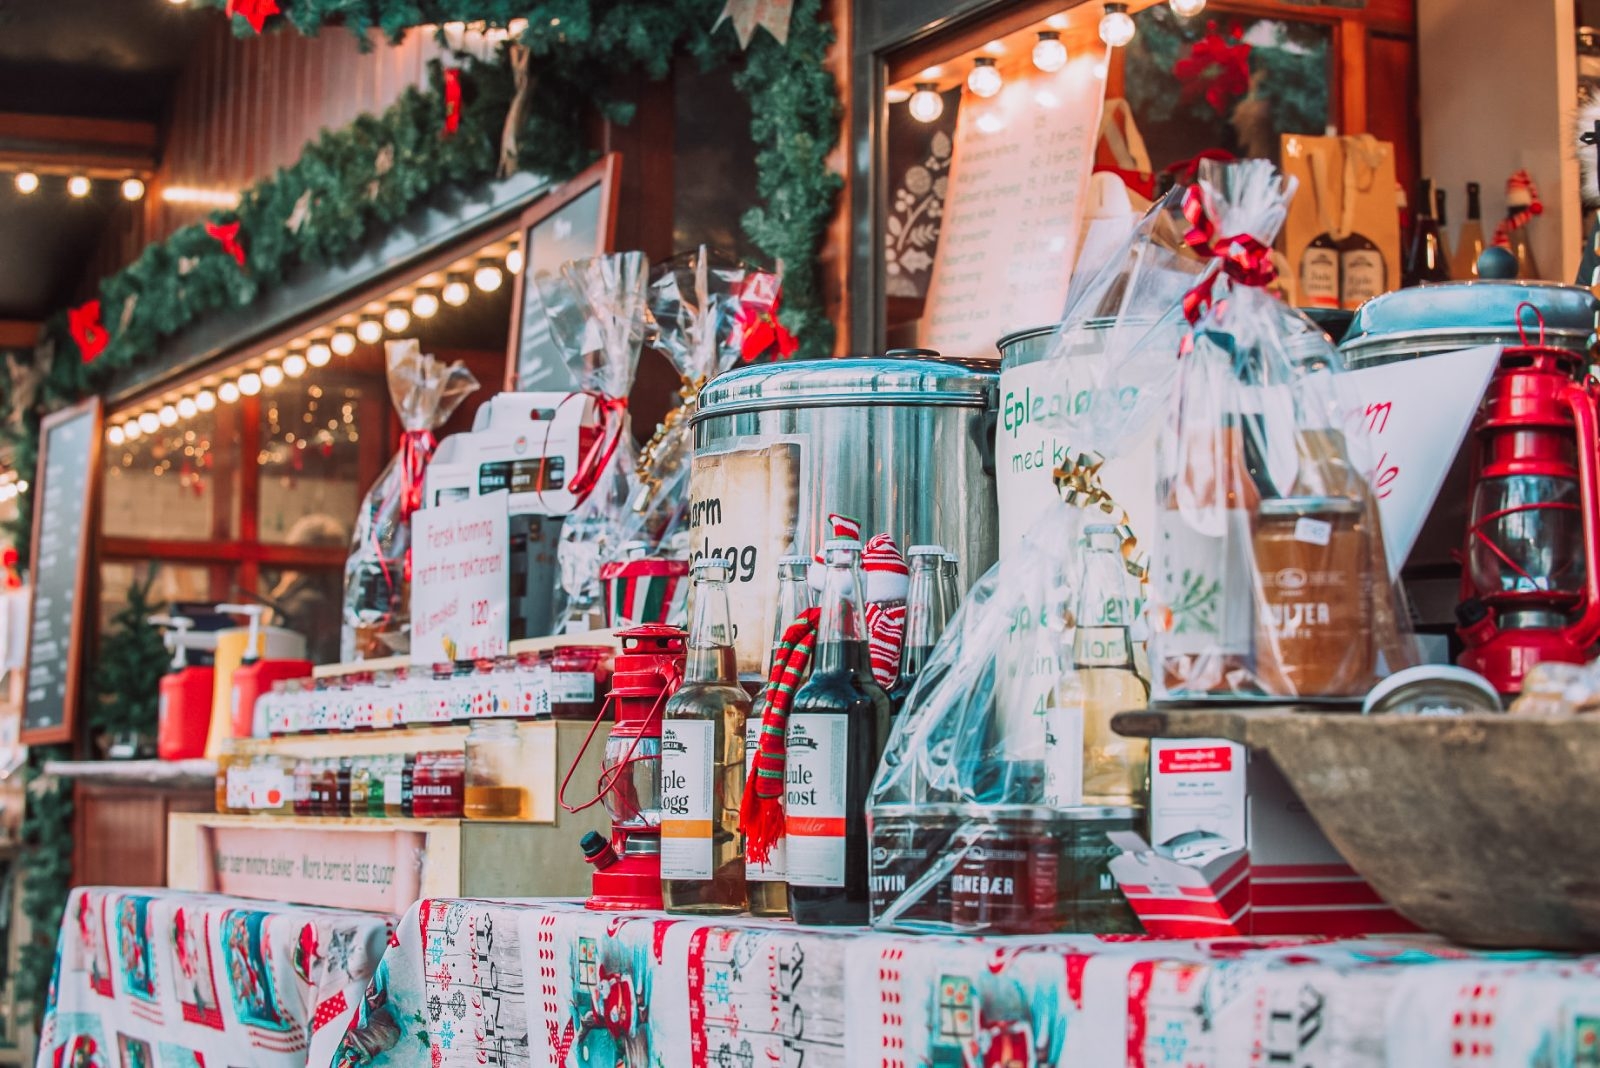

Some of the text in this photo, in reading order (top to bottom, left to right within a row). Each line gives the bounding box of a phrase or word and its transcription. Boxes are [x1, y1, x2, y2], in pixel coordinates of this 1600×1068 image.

[1012, 441, 1044, 473] med
[690, 494, 722, 528] arm
[661, 769, 686, 793] ple
[661, 794, 689, 815] øgg
